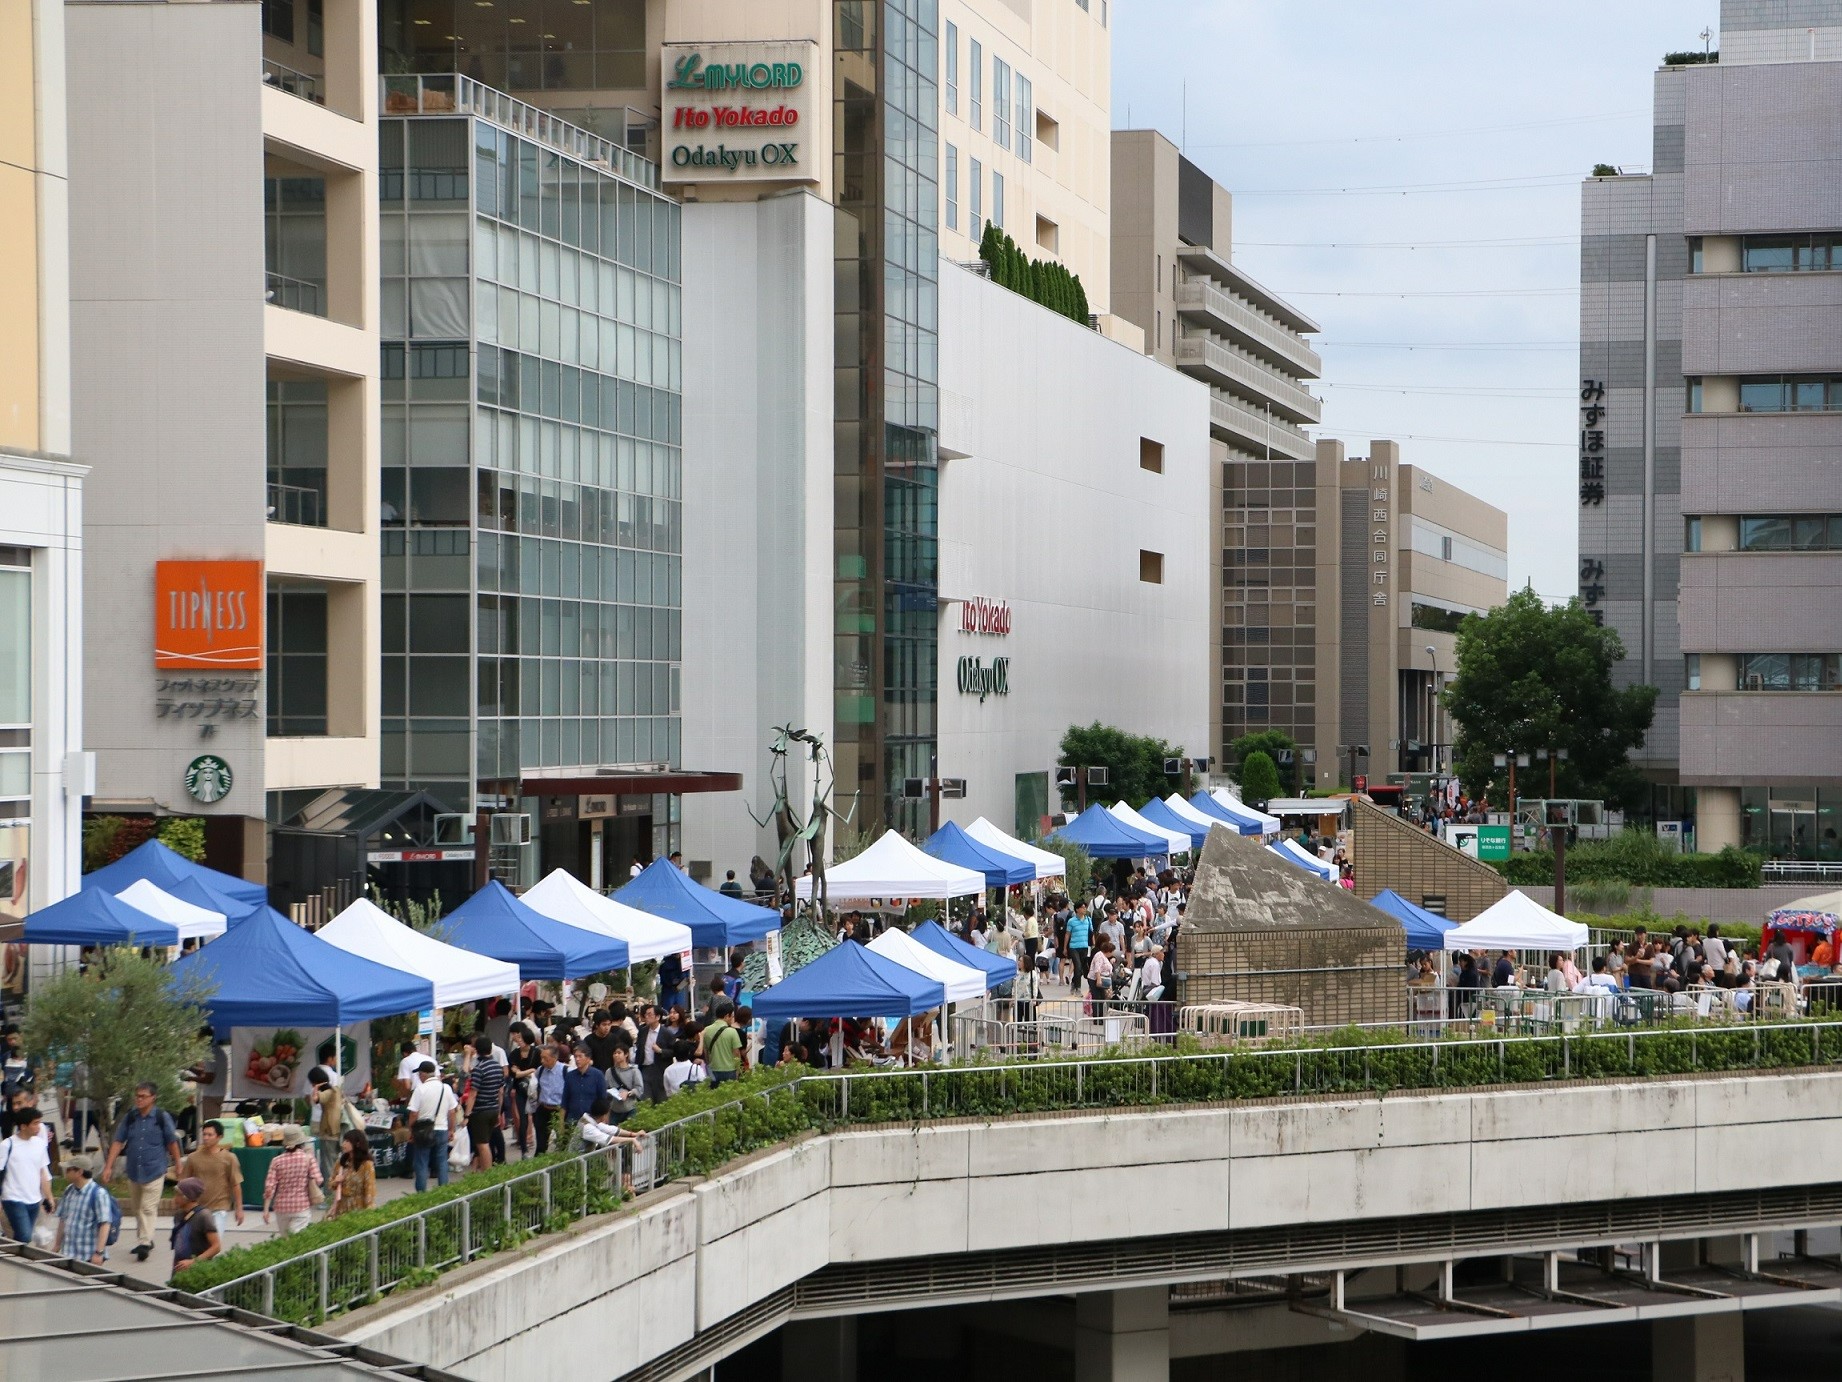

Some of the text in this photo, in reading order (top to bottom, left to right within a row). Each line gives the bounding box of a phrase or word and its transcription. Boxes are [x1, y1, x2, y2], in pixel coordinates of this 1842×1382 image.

[667, 53, 804, 89] L-MYLORD
[673, 104, 799, 128] Ito Yokado
[672, 143, 799, 170] Odakyu OX
[1580, 379, 1605, 506] みずほ証券
[1373, 465, 1388, 606] 川崎西合同庁舎
[169, 579, 248, 641] TIPNESS
[958, 596, 1011, 635] Ito Yokado
[957, 655, 1011, 703] Odakyu OX
